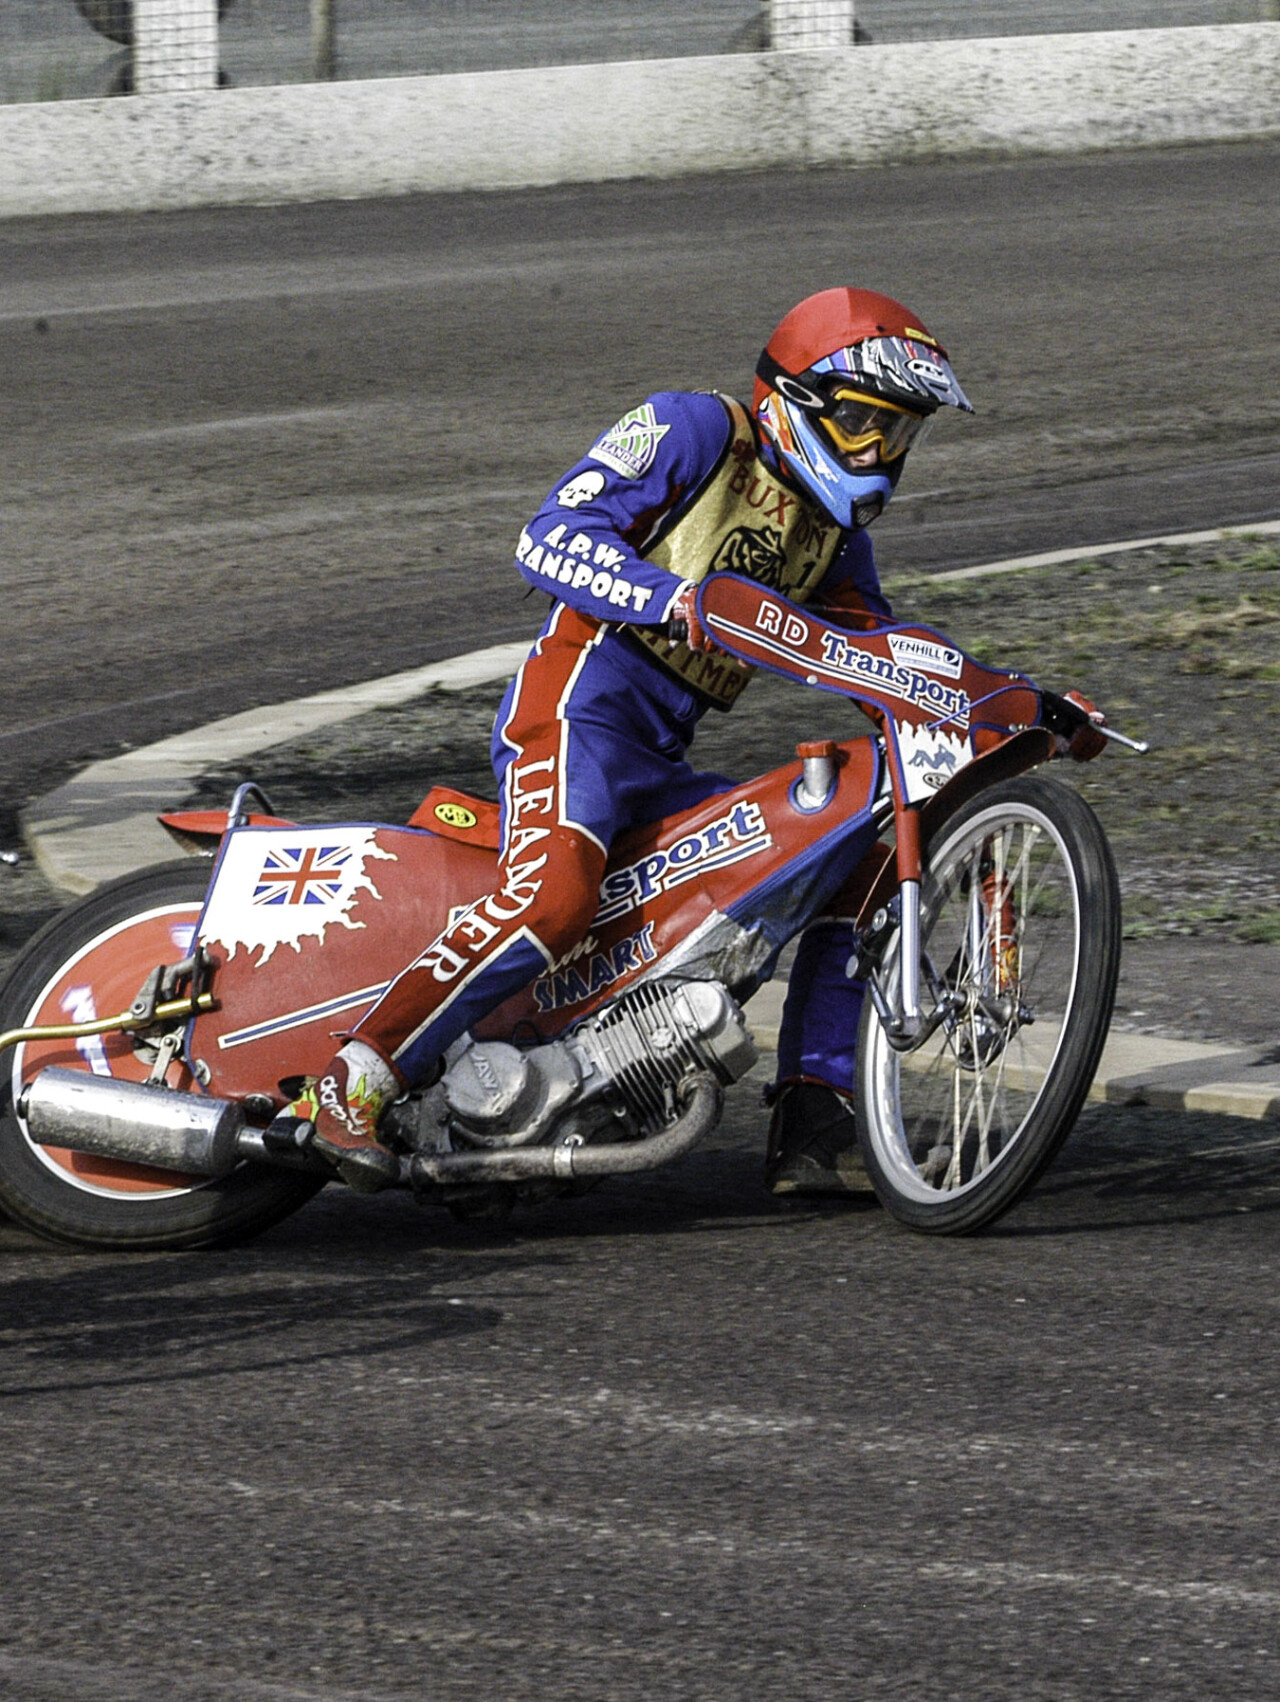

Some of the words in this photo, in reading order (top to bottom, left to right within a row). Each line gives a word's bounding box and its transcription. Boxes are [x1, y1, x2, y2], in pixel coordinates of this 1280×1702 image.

[597, 440, 646, 472] LEANDER
[516, 532, 653, 612] RANSPORT
[544, 523, 626, 573] A.P.W.
[821, 630, 971, 719] Transport
[890, 638, 942, 660] VENHILL
[411, 755, 555, 982] LEANDER
[600, 799, 767, 907] sport
[533, 920, 658, 1013] SMART
